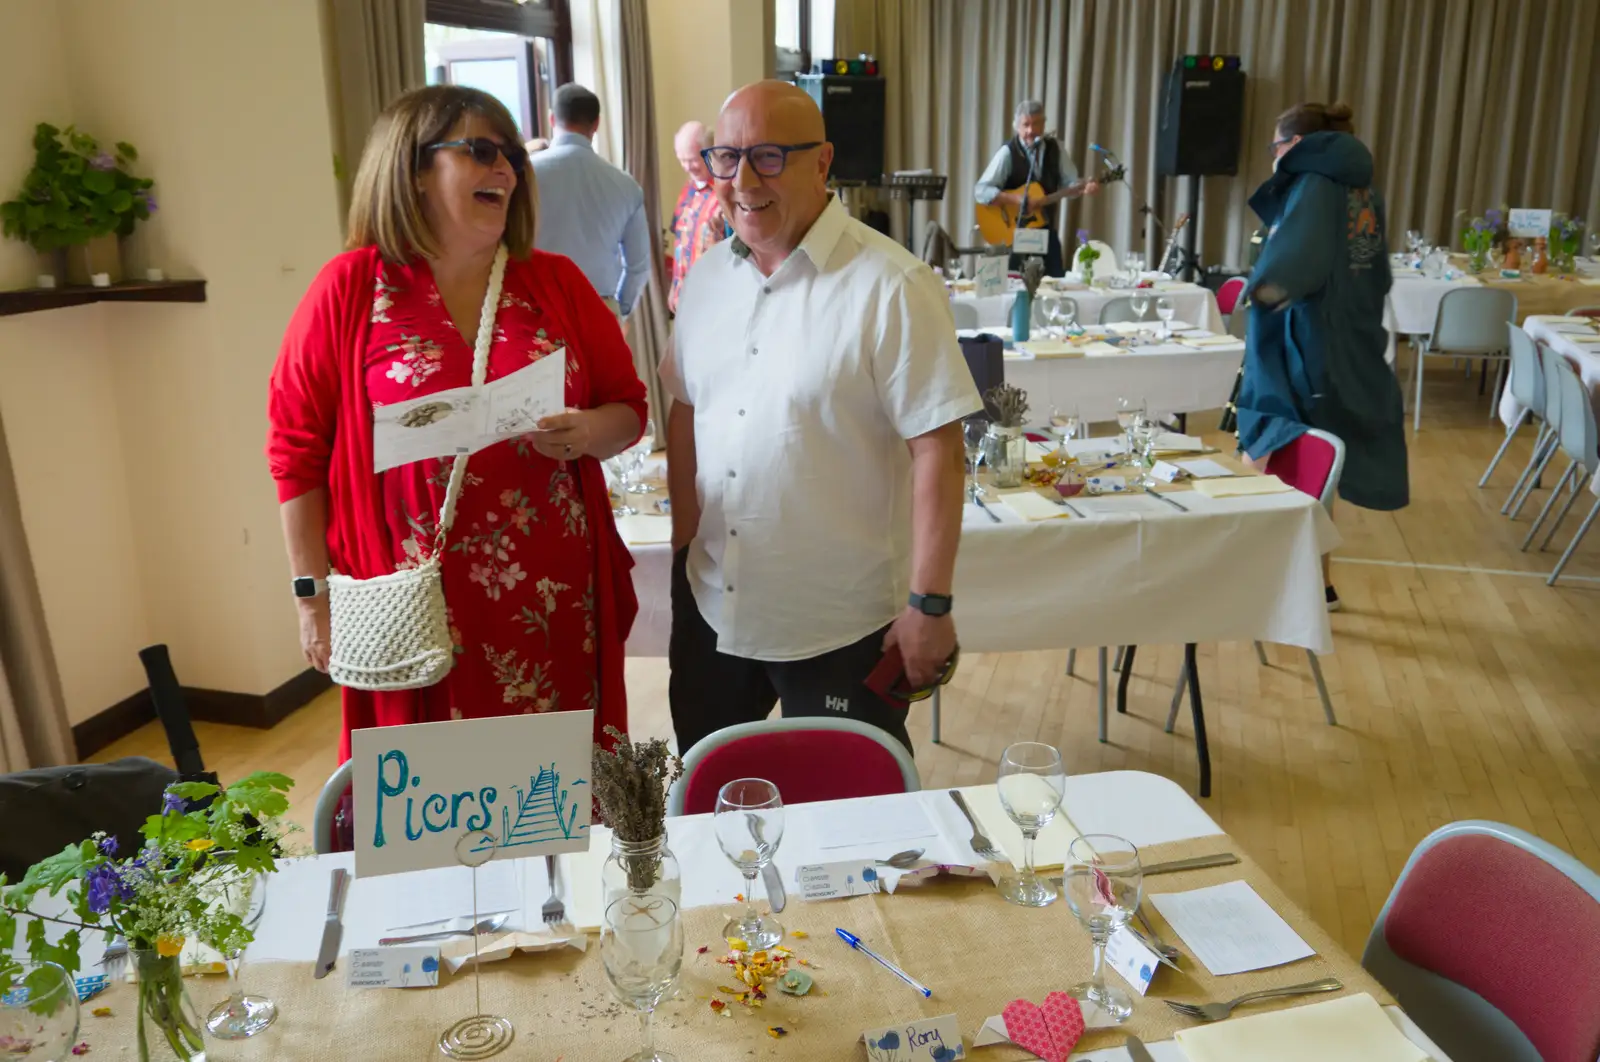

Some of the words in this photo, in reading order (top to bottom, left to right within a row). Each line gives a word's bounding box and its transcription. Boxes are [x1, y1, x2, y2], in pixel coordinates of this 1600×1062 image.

[825, 694, 849, 712] HH
[373, 750, 497, 848] Piers
[905, 1026, 947, 1058] Rory
